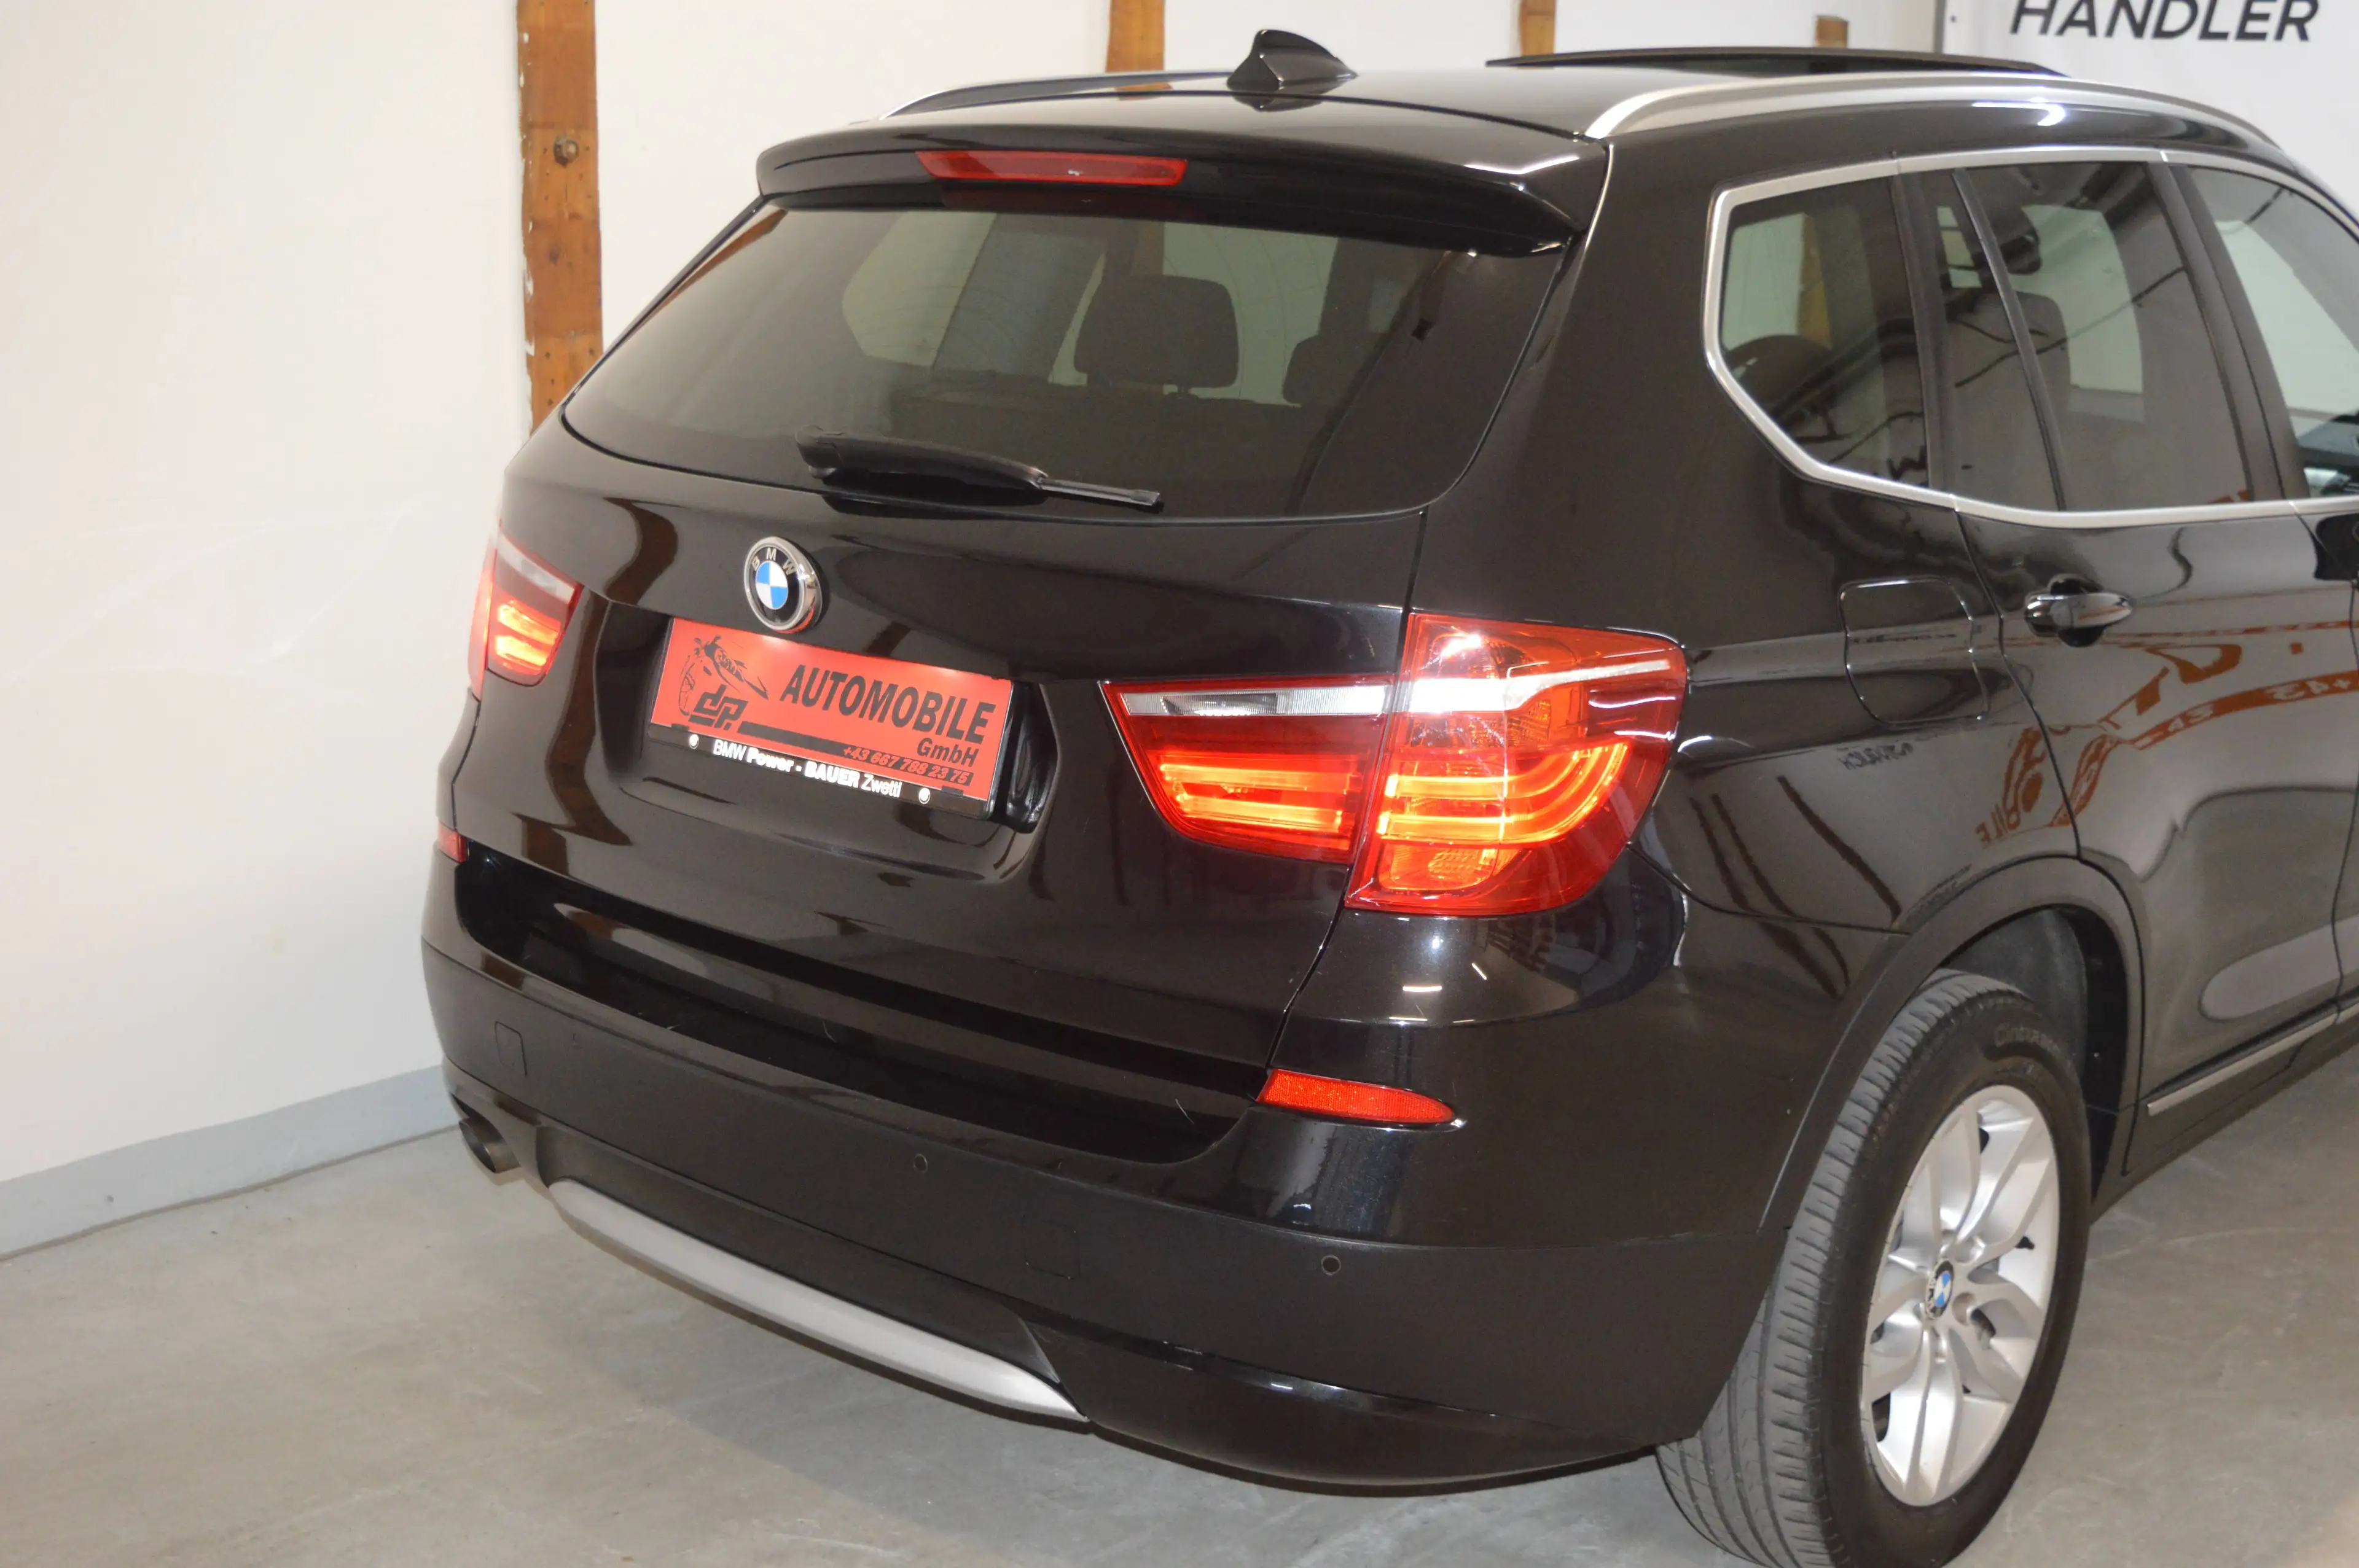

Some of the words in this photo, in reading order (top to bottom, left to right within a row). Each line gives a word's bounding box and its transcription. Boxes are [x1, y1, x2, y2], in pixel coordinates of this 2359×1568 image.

[751, 547, 797, 576] BMW
[780, 665, 996, 744] AUTOMOBILE
[713, 739, 748, 761] BMW
[746, 747, 795, 773] Power
[804, 760, 860, 789] BAUER
[843, 746, 870, 762] +43
[870, 752, 900, 768] 667
[899, 759, 929, 775] 788
[928, 765, 950, 779] 23
[950, 770, 970, 784] 75
[917, 738, 980, 768] GmbH
